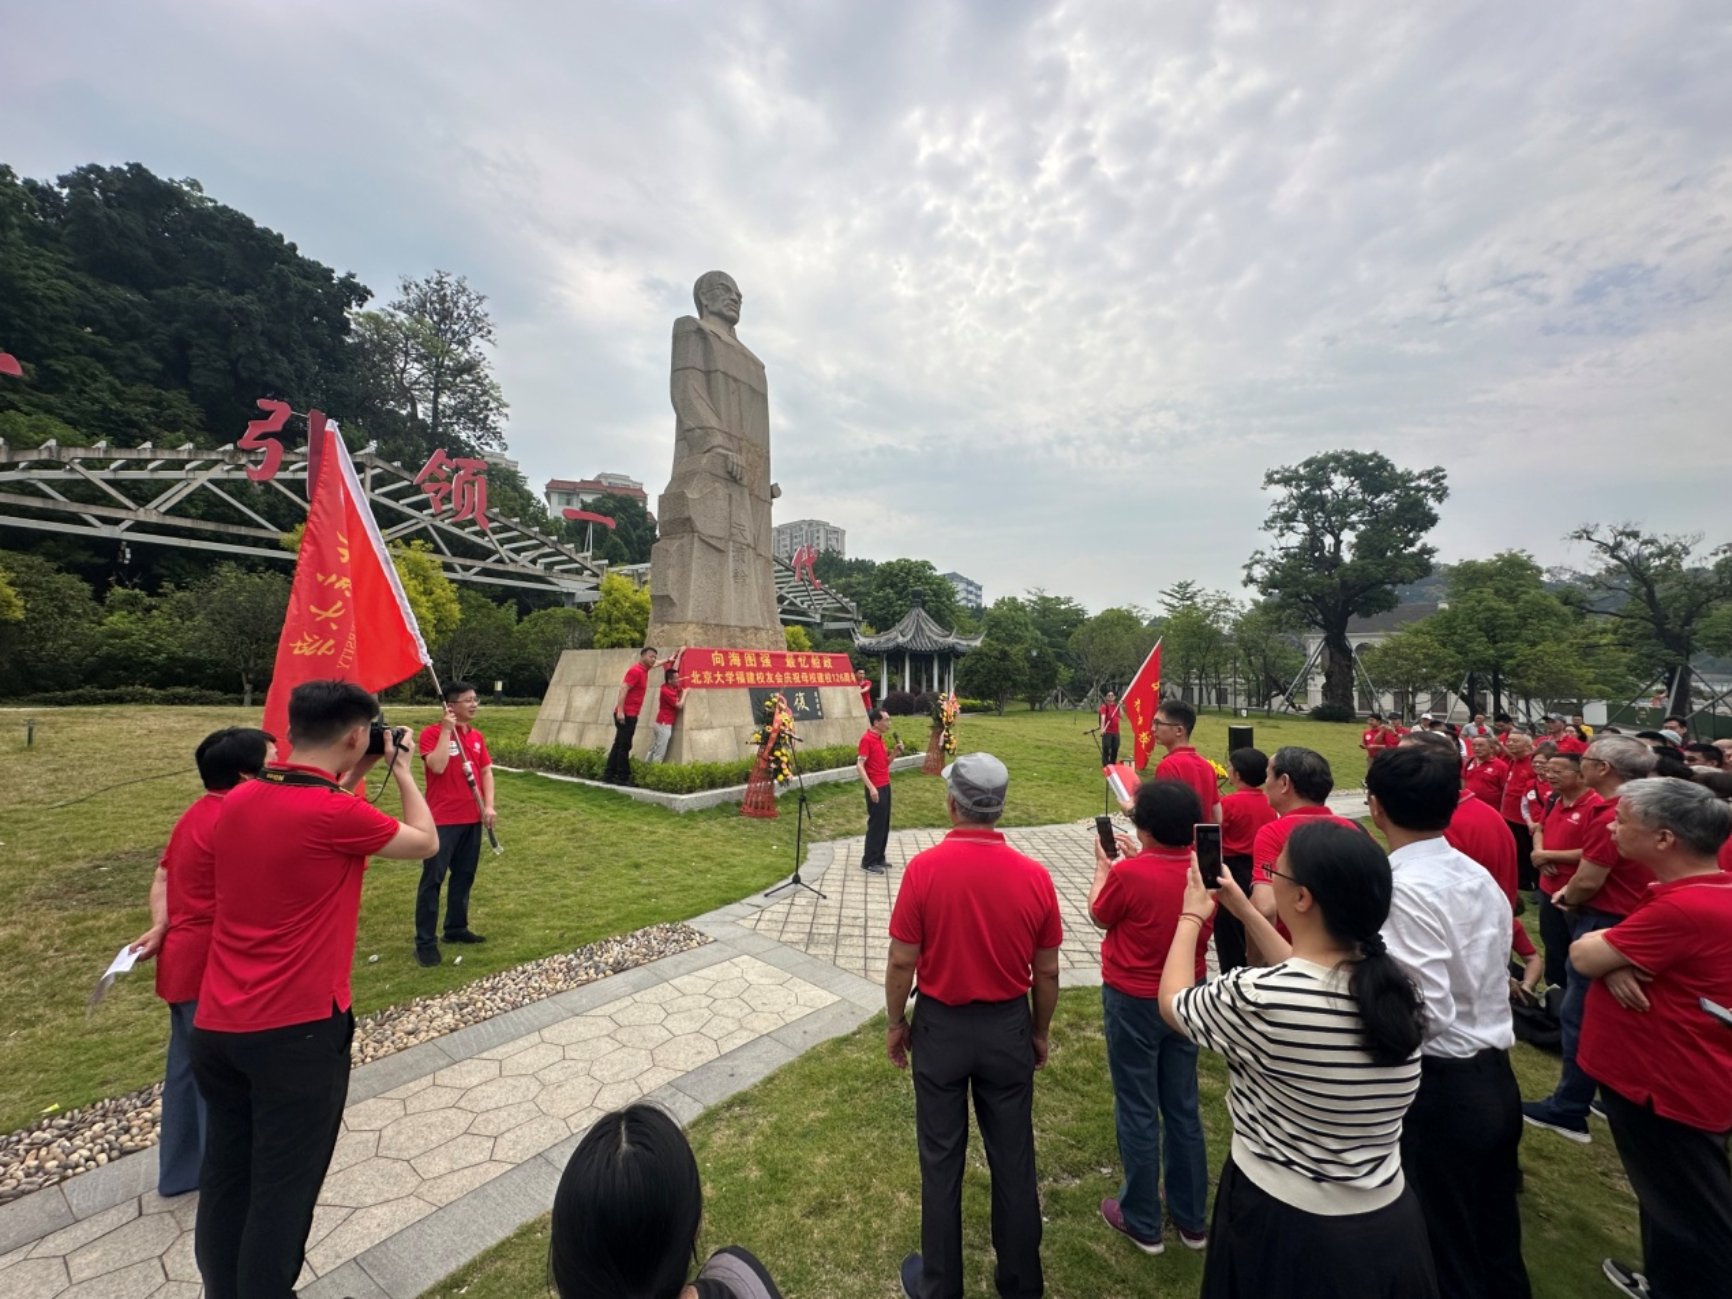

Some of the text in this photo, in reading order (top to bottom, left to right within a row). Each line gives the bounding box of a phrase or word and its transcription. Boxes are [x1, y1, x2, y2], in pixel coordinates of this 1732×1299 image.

[711, 650, 833, 669] 向海图强 最忆船政
